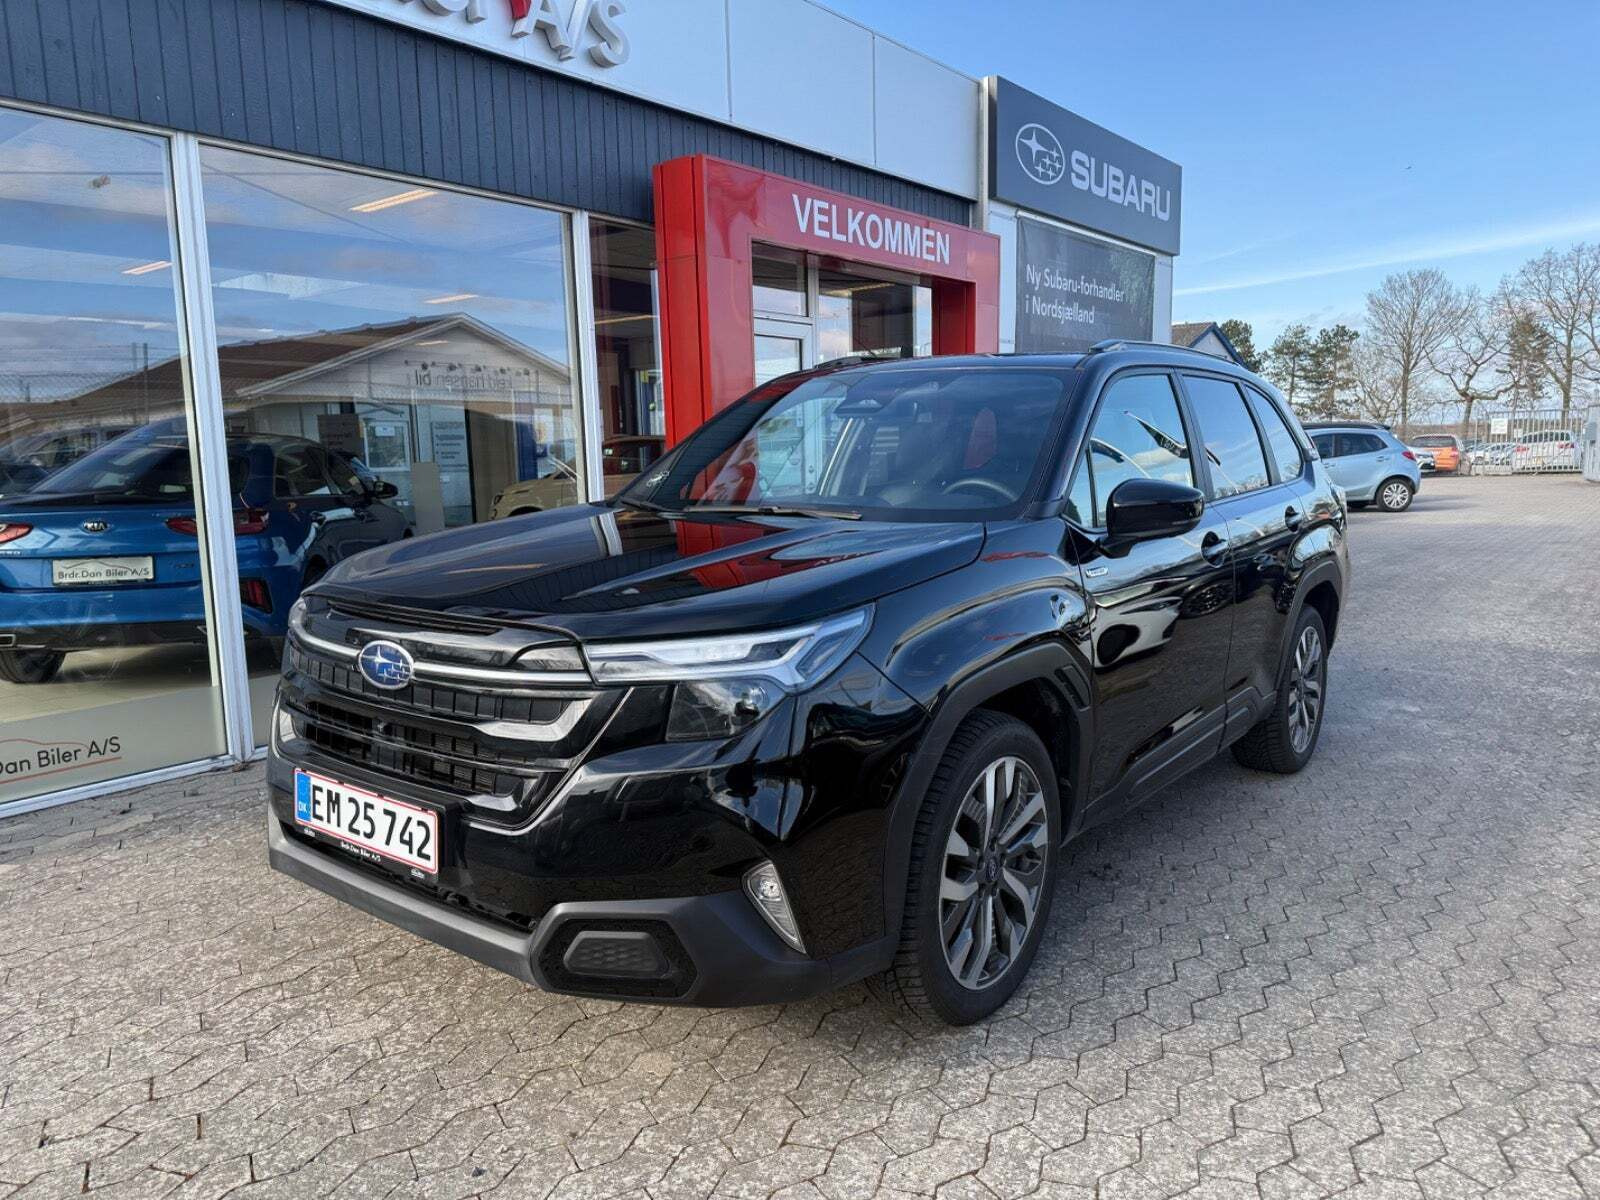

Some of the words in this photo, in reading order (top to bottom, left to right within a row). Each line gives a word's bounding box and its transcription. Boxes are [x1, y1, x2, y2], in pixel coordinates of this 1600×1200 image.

[1070, 150, 1171, 221] SUBARU
[791, 193, 950, 265] VELKOMMEN
[1026, 263, 1041, 291] Ny
[1043, 270, 1125, 303] Subaru-forhandler
[1025, 296, 1029, 314] i
[1031, 296, 1095, 325] Nordsjælland
[84, 521, 105, 531] KIA
[105, 568, 128, 577] Biler
[130, 567, 150, 577] A/S
[37, 746, 81, 768] Biler
[87, 736, 121, 758] A/S
[298, 801, 307, 813] DK
[312, 784, 341, 828] EM
[347, 796, 376, 840] 25
[383, 808, 432, 861] 742
